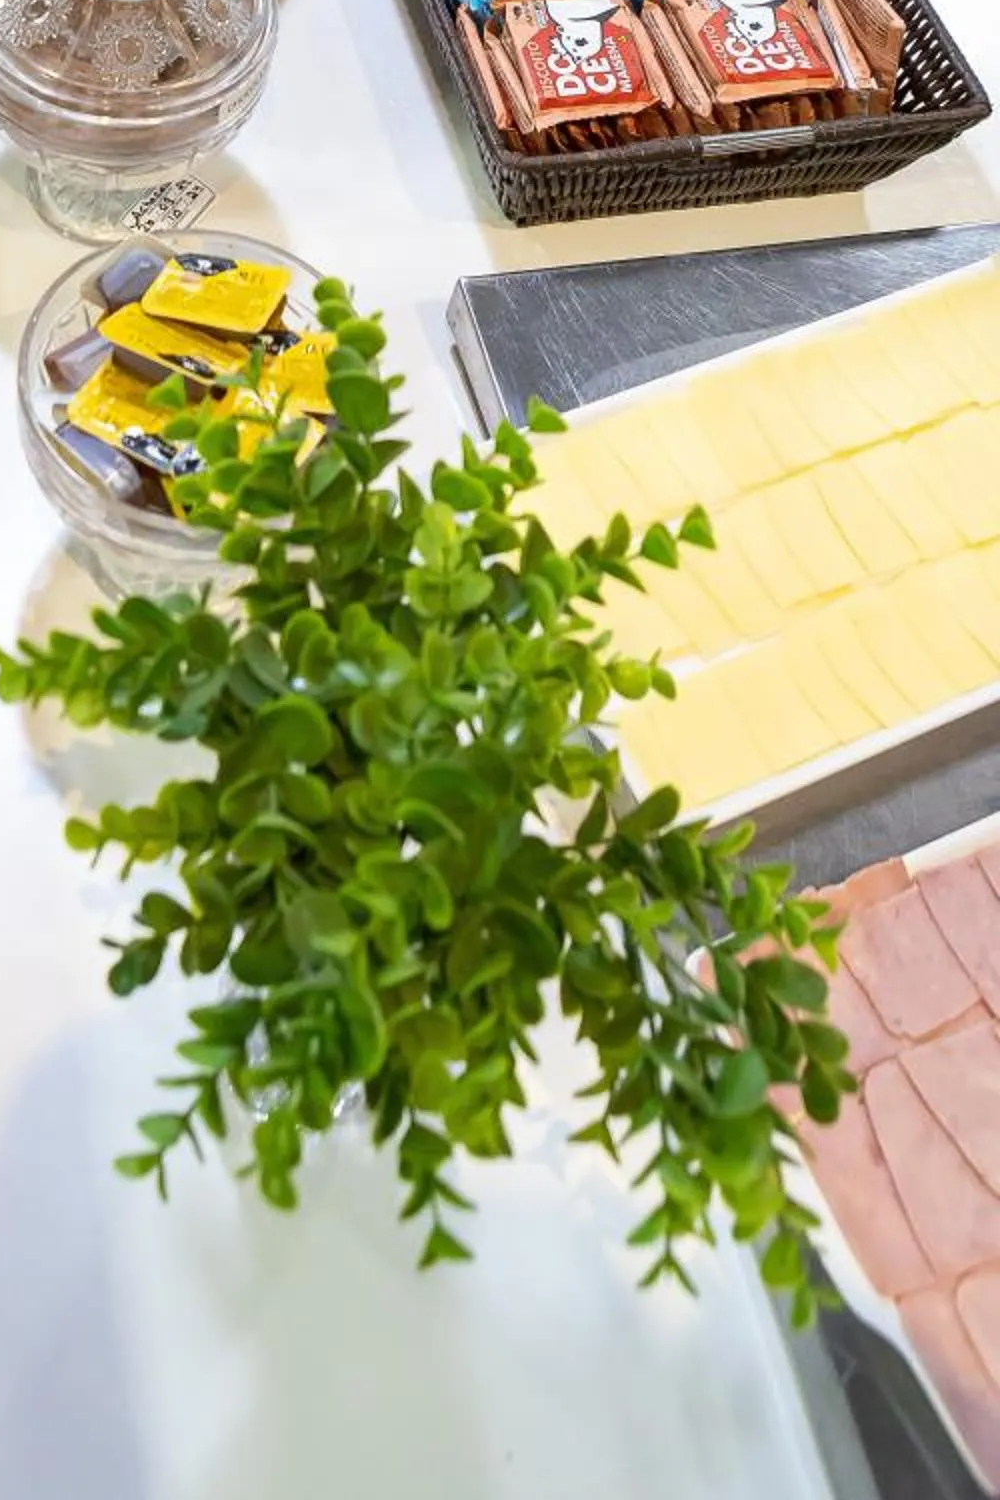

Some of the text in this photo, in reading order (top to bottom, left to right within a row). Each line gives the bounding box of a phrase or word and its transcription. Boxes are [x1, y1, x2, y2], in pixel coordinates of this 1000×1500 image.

[528, 41, 557, 98] BISCOITO
[547, 53, 587, 97] DO
[582, 56, 617, 94] CE
[604, 36, 632, 93] MAISENA
[724, 36, 768, 75] DO
[757, 41, 796, 71] CE
